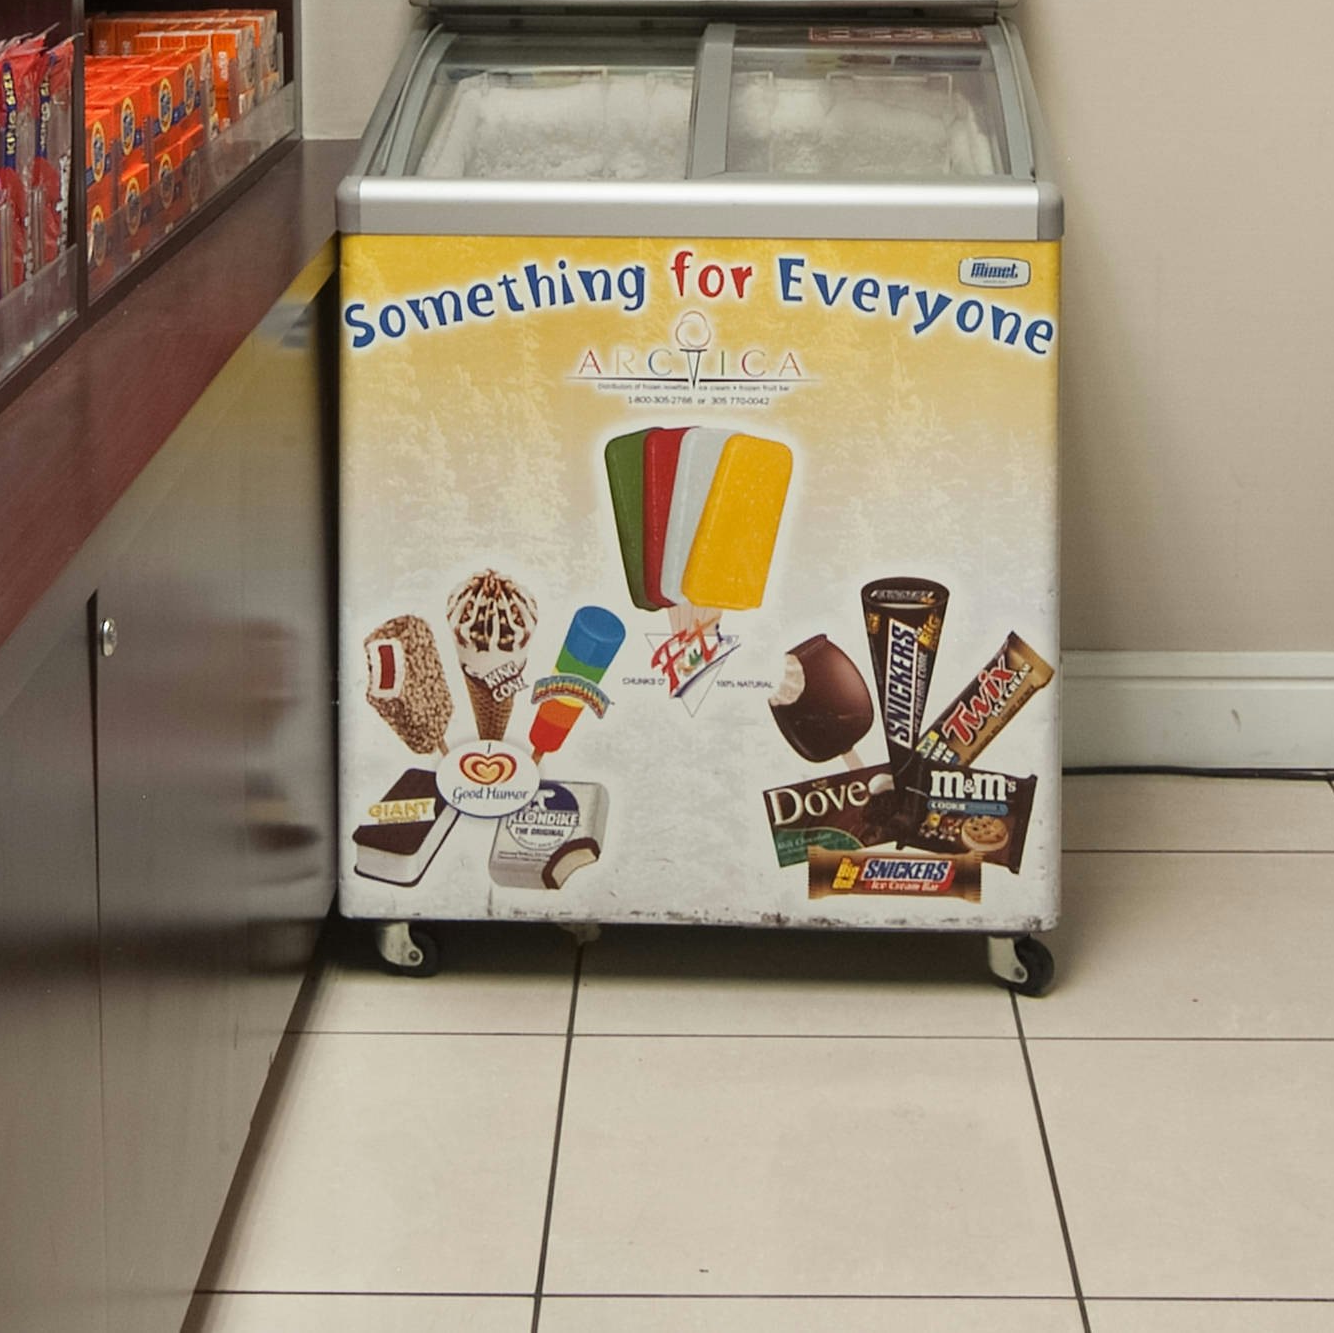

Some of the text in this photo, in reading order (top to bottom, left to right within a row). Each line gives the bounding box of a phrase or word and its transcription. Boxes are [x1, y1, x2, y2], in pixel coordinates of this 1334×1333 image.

[345, 251, 1054, 355] Something for Everyone
[483, 661, 519, 690] KING
[737, 680, 774, 689] NATURAL
[888, 622, 917, 746] SNICKERS
[452, 786, 529, 805] Good Humor
[767, 780, 870, 826] Dove
[369, 799, 431, 819] GIANT
[508, 810, 581, 827] KLONDIKE
[530, 828, 565, 837] ORIGINAL
[863, 859, 952, 881] SNICKERS
[870, 882, 886, 891] Ice
[888, 882, 920, 892] Cream
